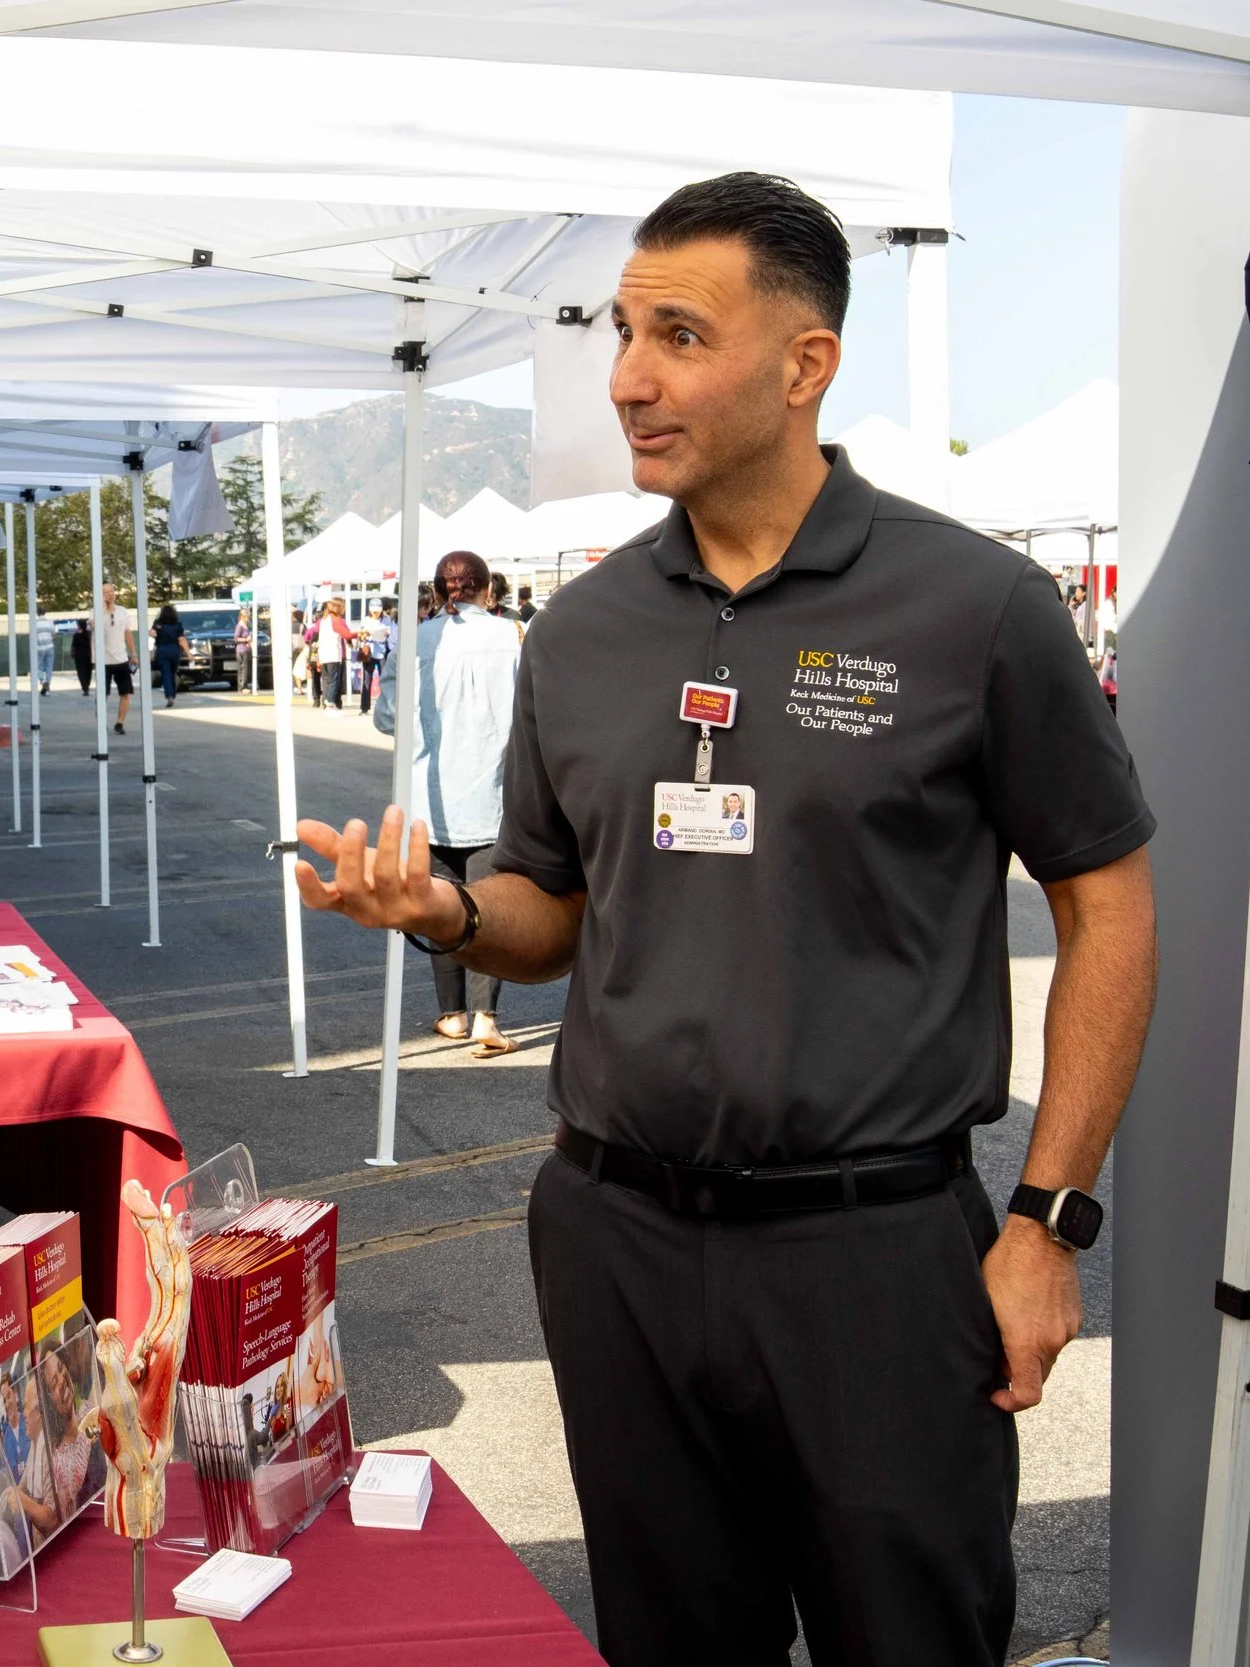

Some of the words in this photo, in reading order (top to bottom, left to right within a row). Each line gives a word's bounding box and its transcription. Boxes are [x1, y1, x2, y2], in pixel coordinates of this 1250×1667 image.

[798, 650, 834, 668] USC
[836, 653, 897, 678] Verdugo
[793, 668, 832, 686] Hills
[834, 672, 899, 695] Hospital
[790, 688, 809, 699] Keck
[810, 691, 846, 702] Medicine
[846, 695, 857, 703] of
[856, 695, 876, 705] USC
[785, 702, 812, 716] Our
[814, 705, 865, 722] Patients
[867, 713, 894, 725] and
[800, 716, 828, 729] Our
[830, 719, 874, 737] People
[662, 793, 678, 802] USC
[678, 794, 706, 806] Verdugo
[662, 802, 679, 811] Hills
[679, 803, 707, 814] Hospital
[33, 1250, 47, 1267] USC
[45, 1242, 65, 1259] Verdugo
[34, 1266, 48, 1282] Hills
[47, 1252, 67, 1274] Hospital
[244, 1298, 261, 1315] Hills
[260, 1285, 282, 1306] Hospital
[245, 1283, 261, 1300] USC
[260, 1275, 282, 1293] Verdugo
[0, 1310, 16, 1331] Rehab
[4, 1323, 22, 1342] Center
[242, 1319, 292, 1355] Speech-Language
[241, 1345, 270, 1370] Pathology
[269, 1333, 293, 1353] Services
